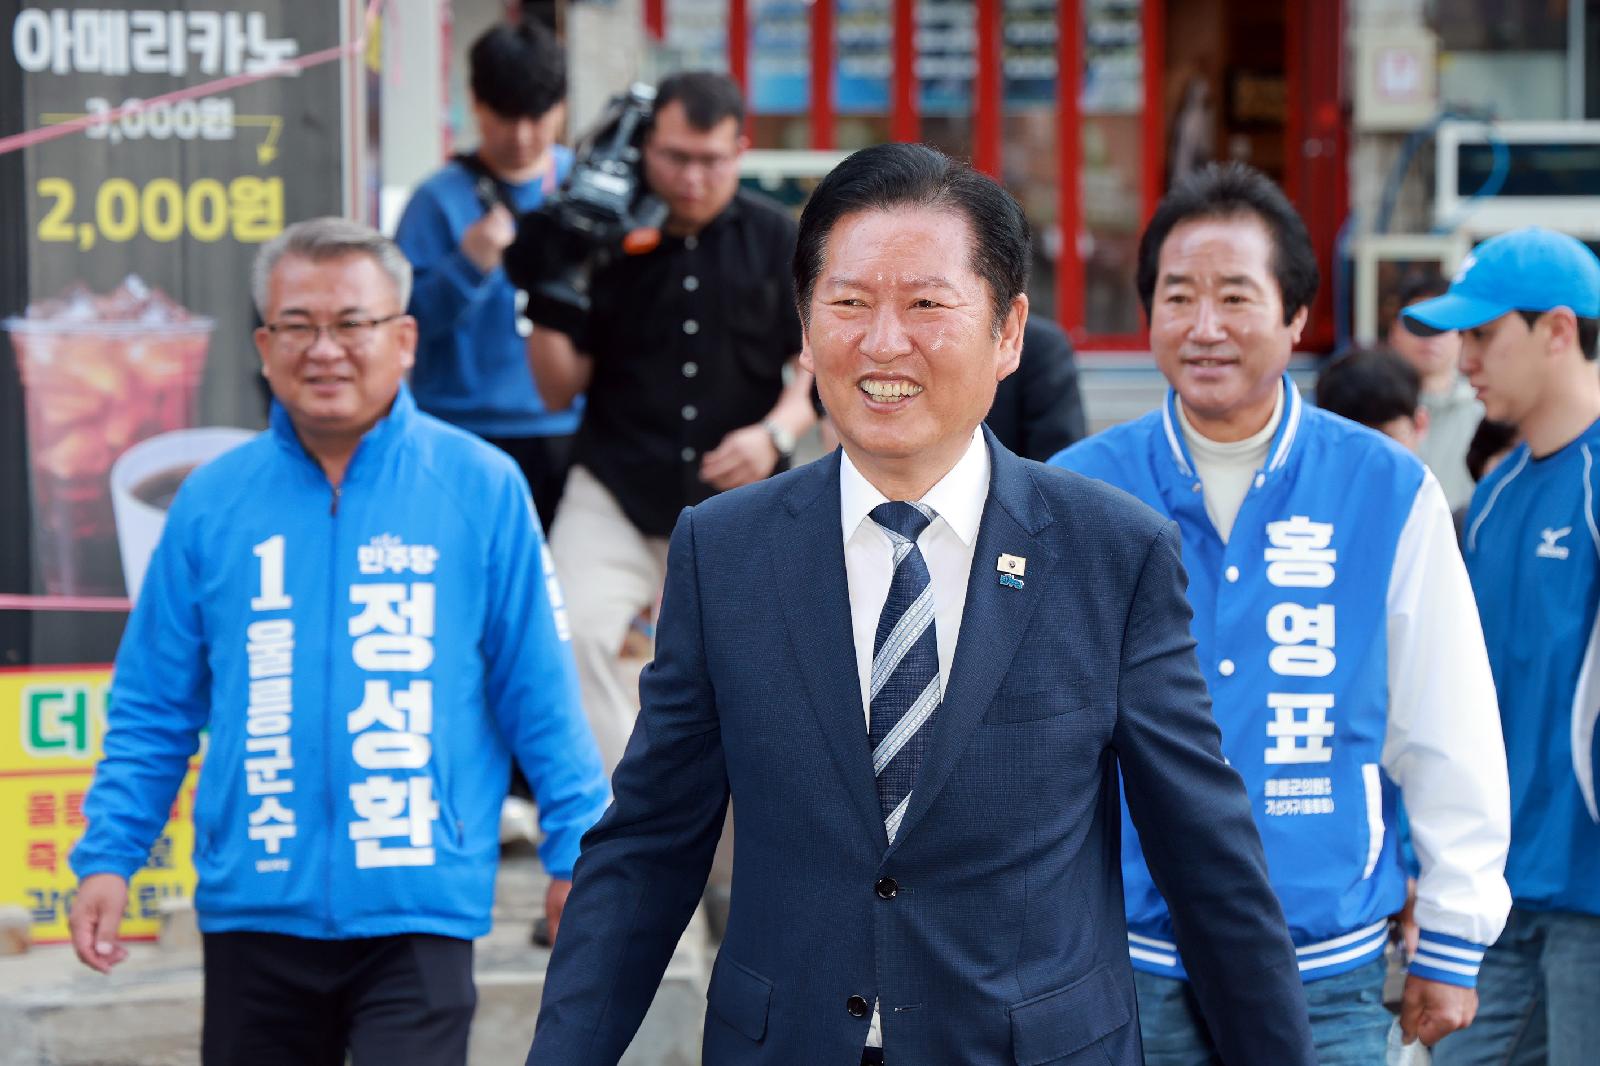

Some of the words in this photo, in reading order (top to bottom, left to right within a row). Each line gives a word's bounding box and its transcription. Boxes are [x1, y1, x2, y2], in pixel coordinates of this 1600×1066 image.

[13, 9, 301, 76] 아메리카노
[85, 97, 235, 144] 3,000원
[37, 176, 284, 251] 2,000원
[253, 534, 293, 611] 1
[357, 543, 440, 574] 민주당
[1264, 515, 1337, 764] 홍영표
[244, 618, 296, 854] 울릉군수
[347, 582, 440, 870] 정성환
